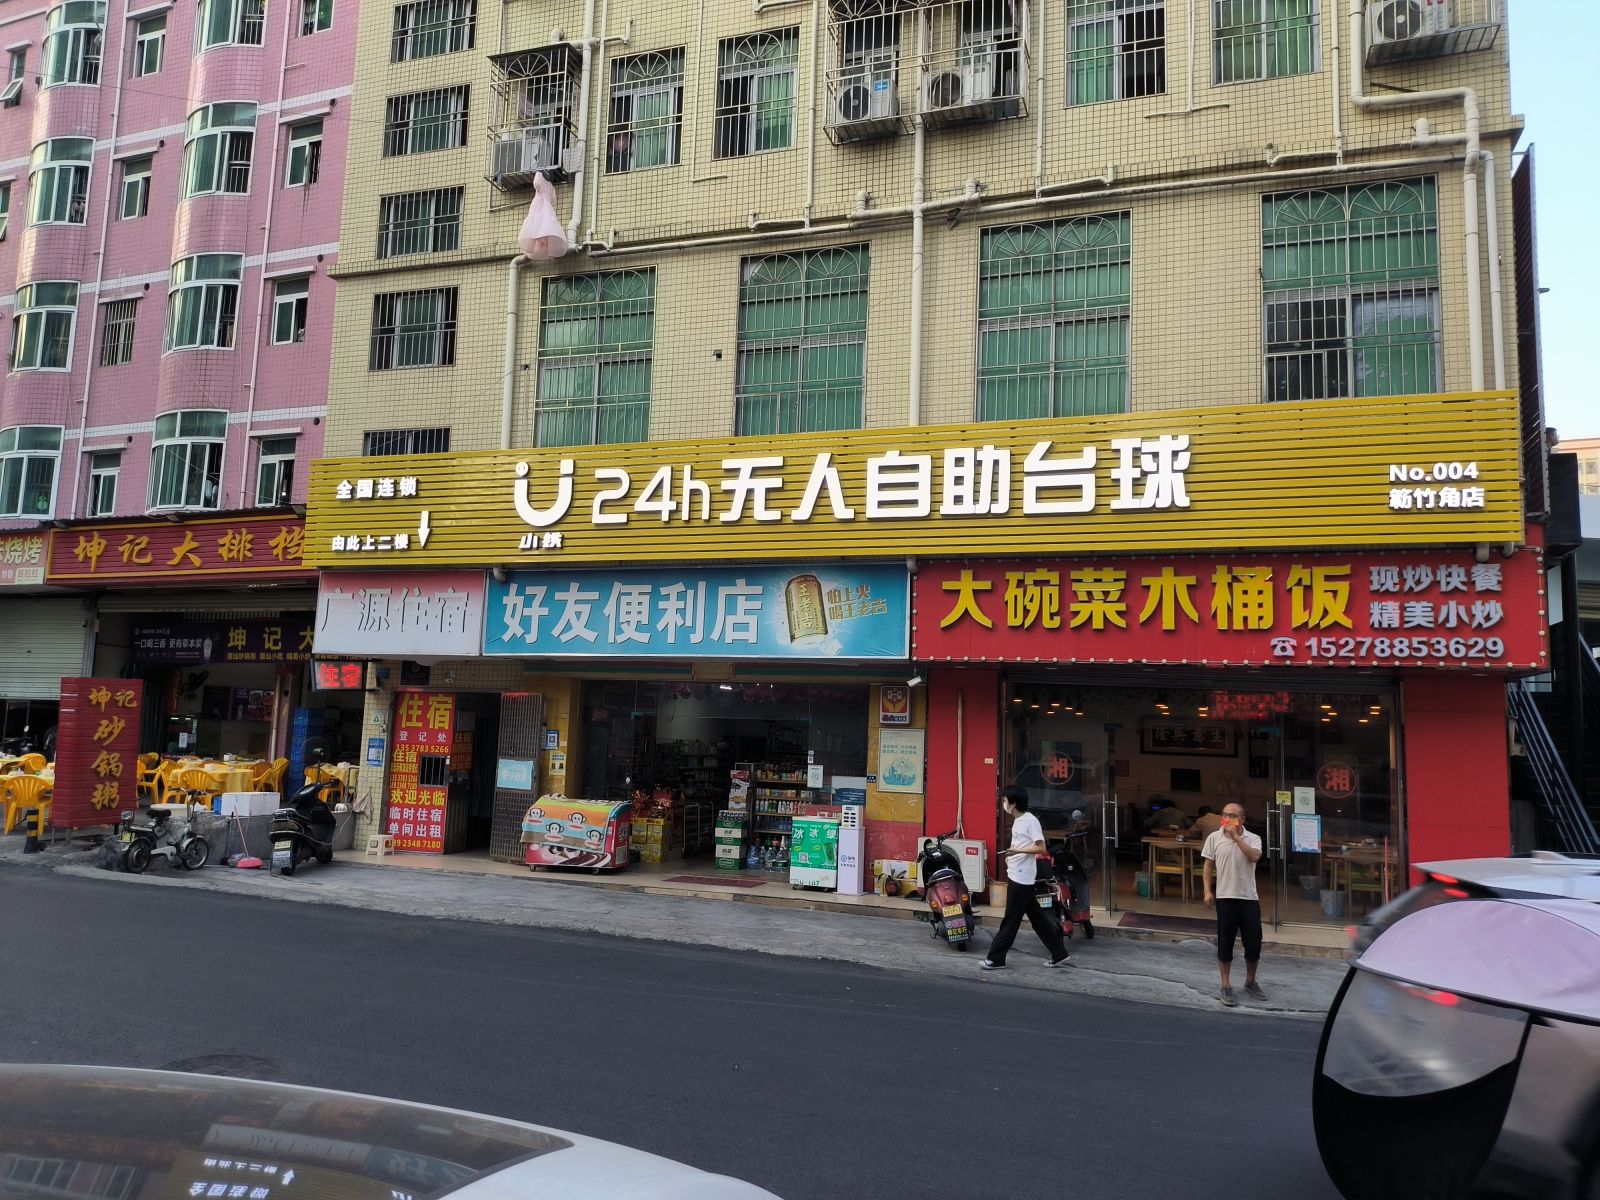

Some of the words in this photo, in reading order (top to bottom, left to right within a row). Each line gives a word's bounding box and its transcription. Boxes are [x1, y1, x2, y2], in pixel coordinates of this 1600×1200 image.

[591, 434, 1191, 526] 24h无人自助台球
[1389, 462, 1478, 481] No.004
[336, 477, 418, 499] 全国连锁
[0, 535, 43, 564] 烧烤
[74, 526, 305, 572] 坤记大排档
[332, 533, 409, 551] 由此上二楼
[1369, 564, 1503, 592] 现炒快餐
[799, 583, 813, 628] 王老吉
[827, 584, 870, 604] 怕上火
[939, 563, 1354, 632] 大碗菜木桶饭
[320, 587, 469, 633] 广源住宿
[501, 579, 765, 645] 好友便利店
[829, 598, 888, 620] 喝王老吉
[1369, 600, 1504, 629] 精美小炒
[1305, 636, 1505, 658] 15278853629
[319, 664, 362, 688] 住宿
[89, 687, 138, 711] 坤记
[399, 693, 453, 729] 住宿
[399, 730, 447, 743] 登记处
[393, 751, 418, 763] 住宿
[396, 744, 411, 752] 135
[411, 745, 429, 753] 3783
[90, 716, 126, 811] 砂锅粥
[1046, 757, 1069, 779] 湘
[1324, 767, 1353, 793] 湘
[390, 789, 446, 806] 欢迎光临
[389, 806, 443, 822] 临时住宿
[388, 822, 442, 837] 单间出租
[402, 839, 421, 848] 2348
[422, 840, 441, 849] 7180
